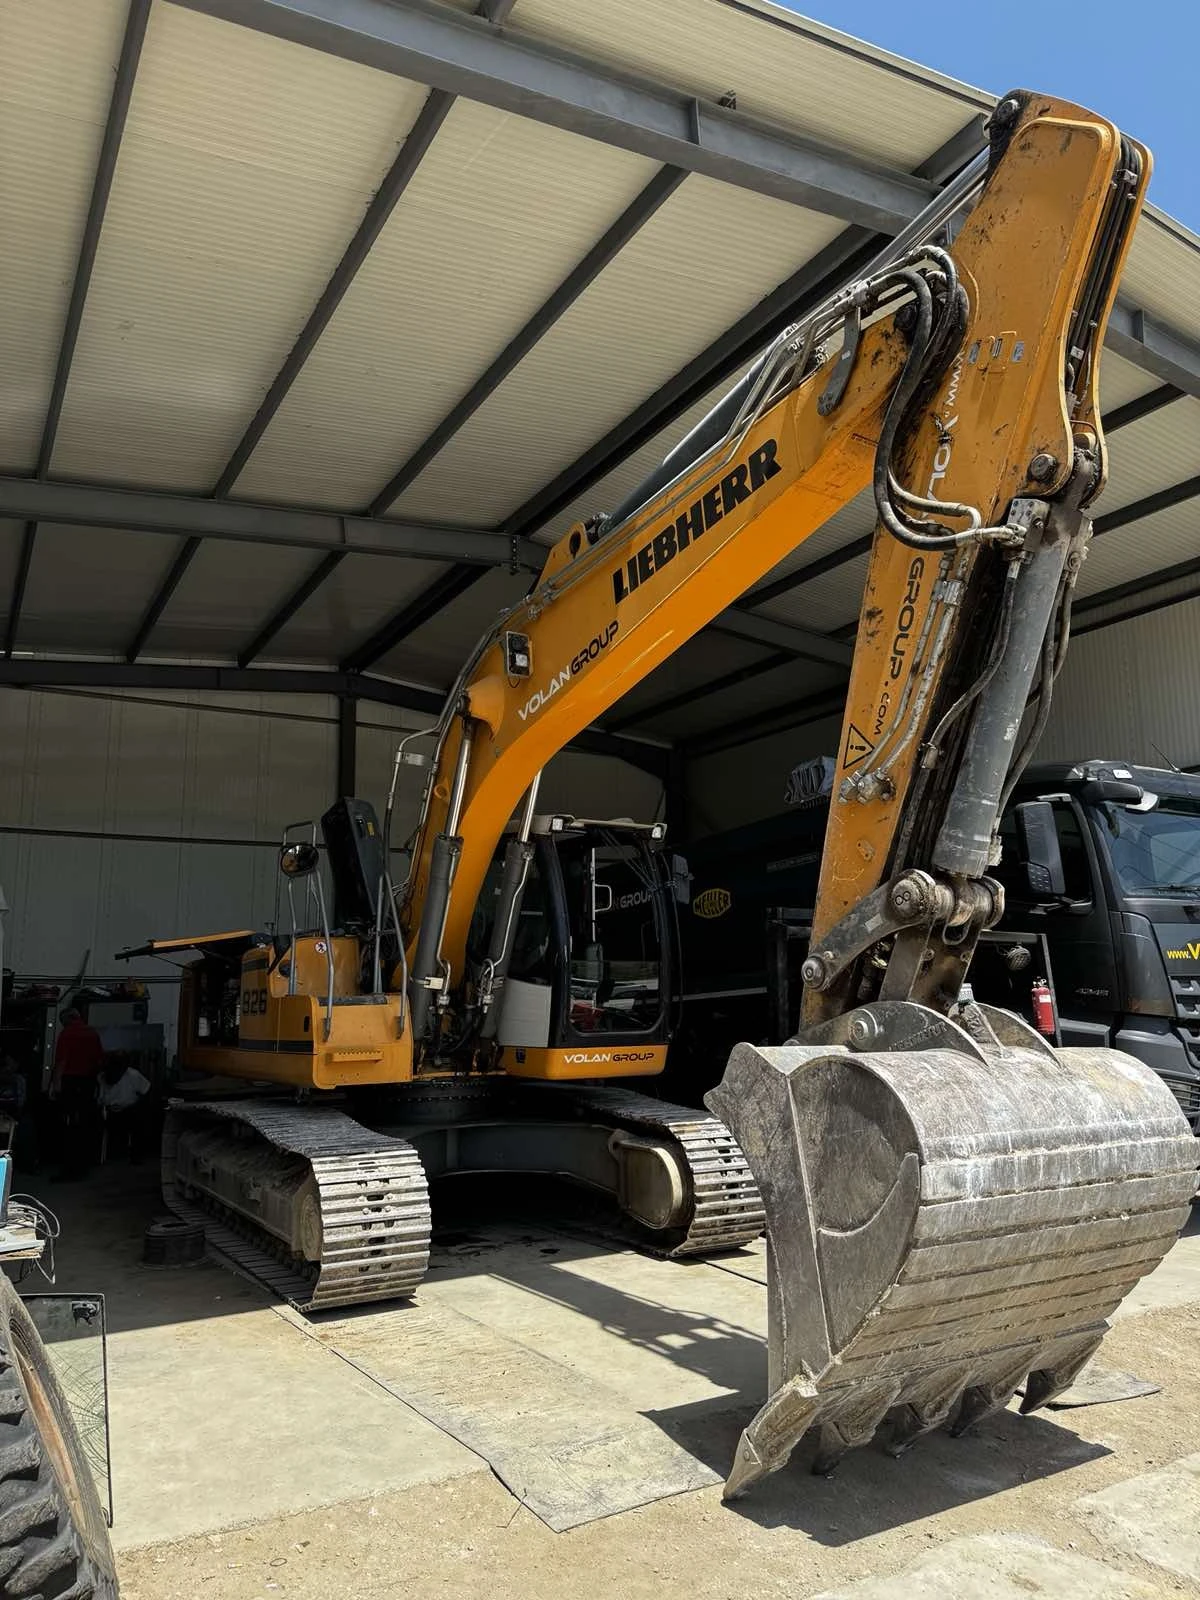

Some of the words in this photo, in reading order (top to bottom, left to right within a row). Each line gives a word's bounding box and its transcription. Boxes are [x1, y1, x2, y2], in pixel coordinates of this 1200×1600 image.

[612, 438, 782, 605] LIEBHERR
[517, 665, 572, 721] VOLAN
[570, 619, 620, 675] GROUP
[563, 1052, 611, 1064] VOLAN
[612, 1052, 655, 1063] GROUP
